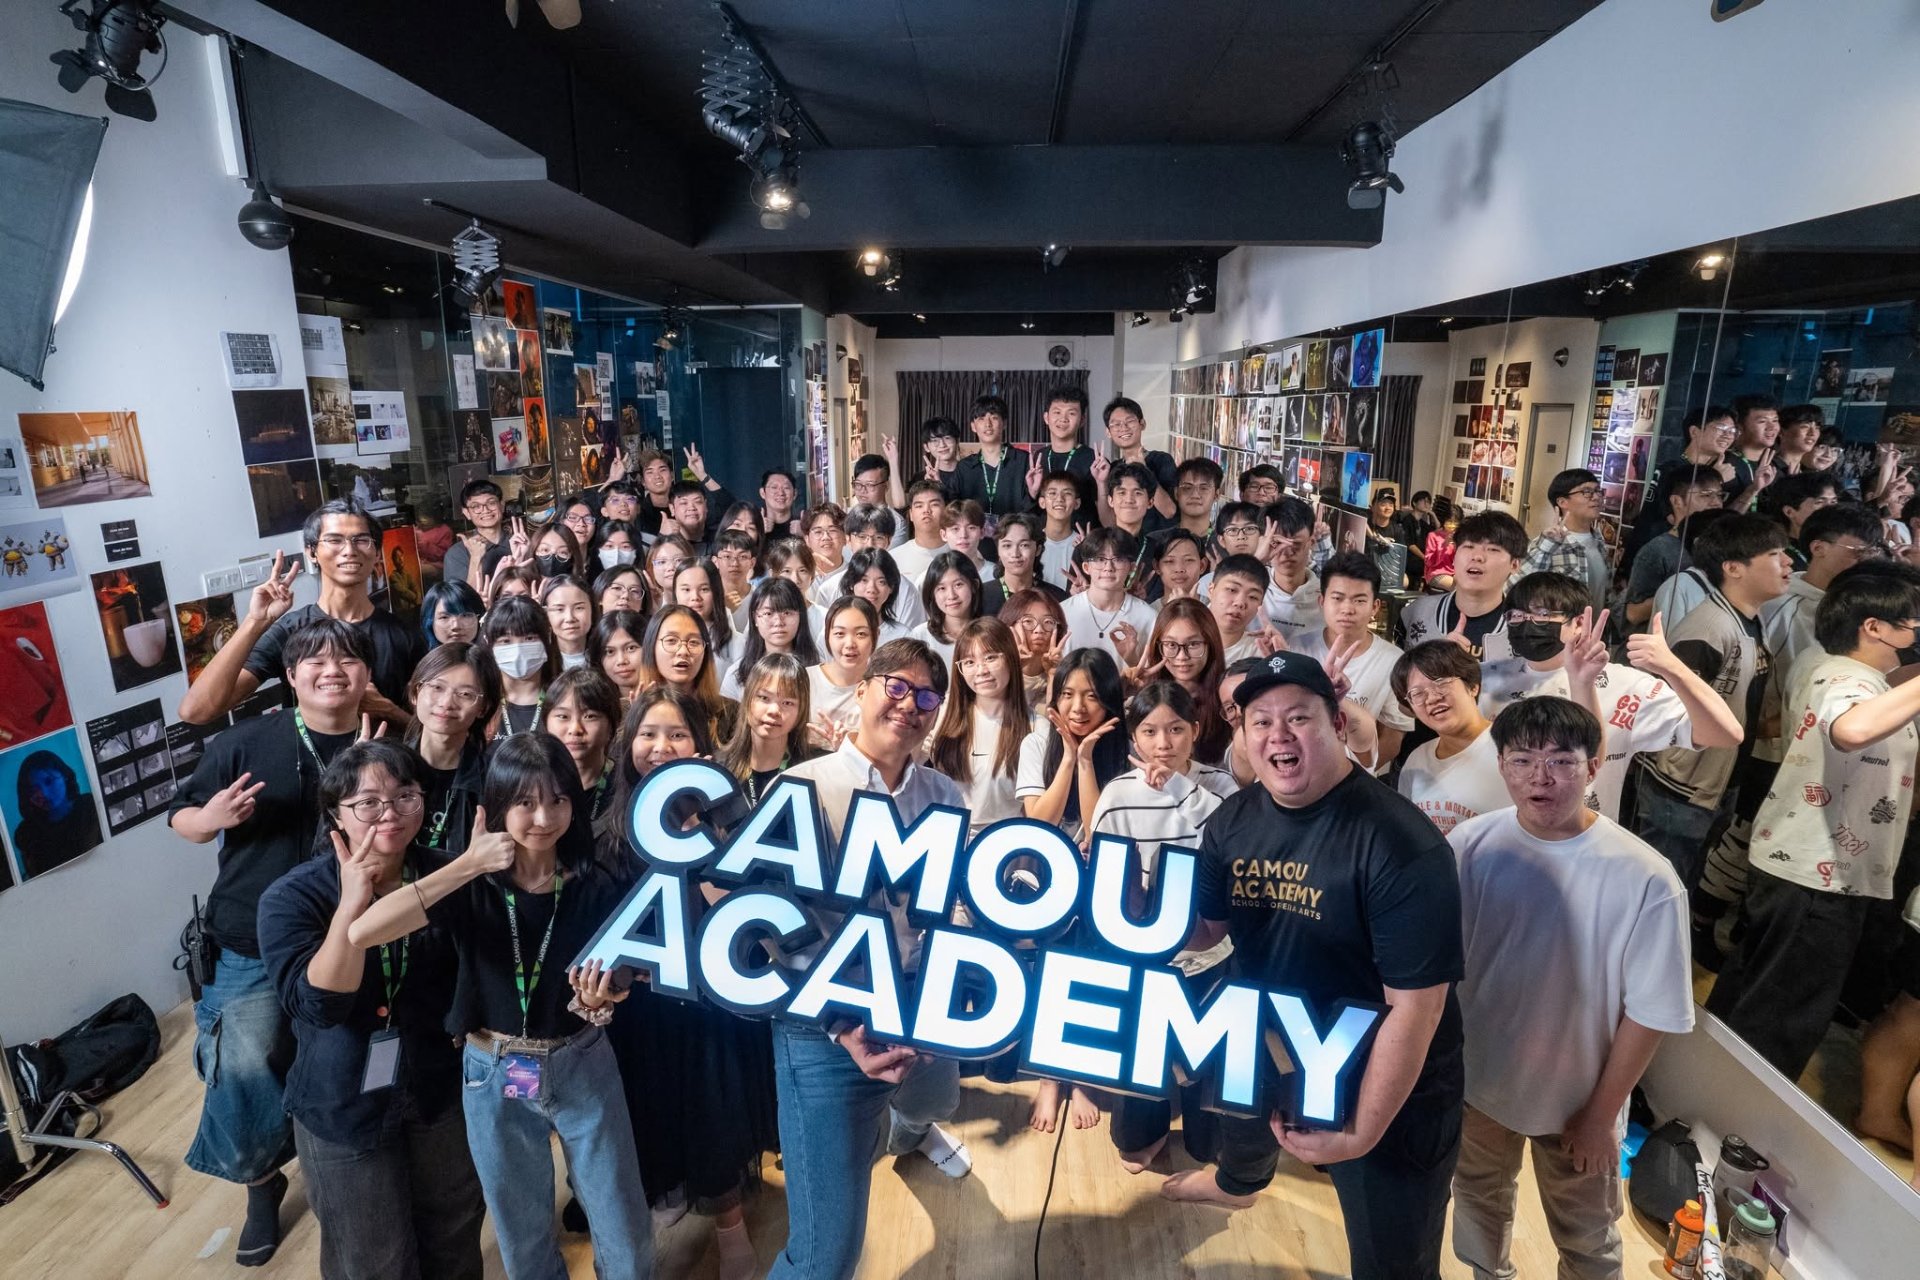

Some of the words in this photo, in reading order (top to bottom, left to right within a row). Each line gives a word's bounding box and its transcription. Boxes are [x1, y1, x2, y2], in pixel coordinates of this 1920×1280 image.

[1434, 800, 1441, 810] &
[631, 763, 1196, 954] CAMOU
[1232, 859, 1308, 880] CAMOU
[1231, 880, 1323, 908] ACADEMY
[508, 906, 518, 936] ACADEMY
[1297, 909, 1322, 920] ARTS
[512, 939, 521, 963] CAMOU
[538, 931, 551, 962] ACADEMY
[576, 874, 1379, 1121] ACADEMY
